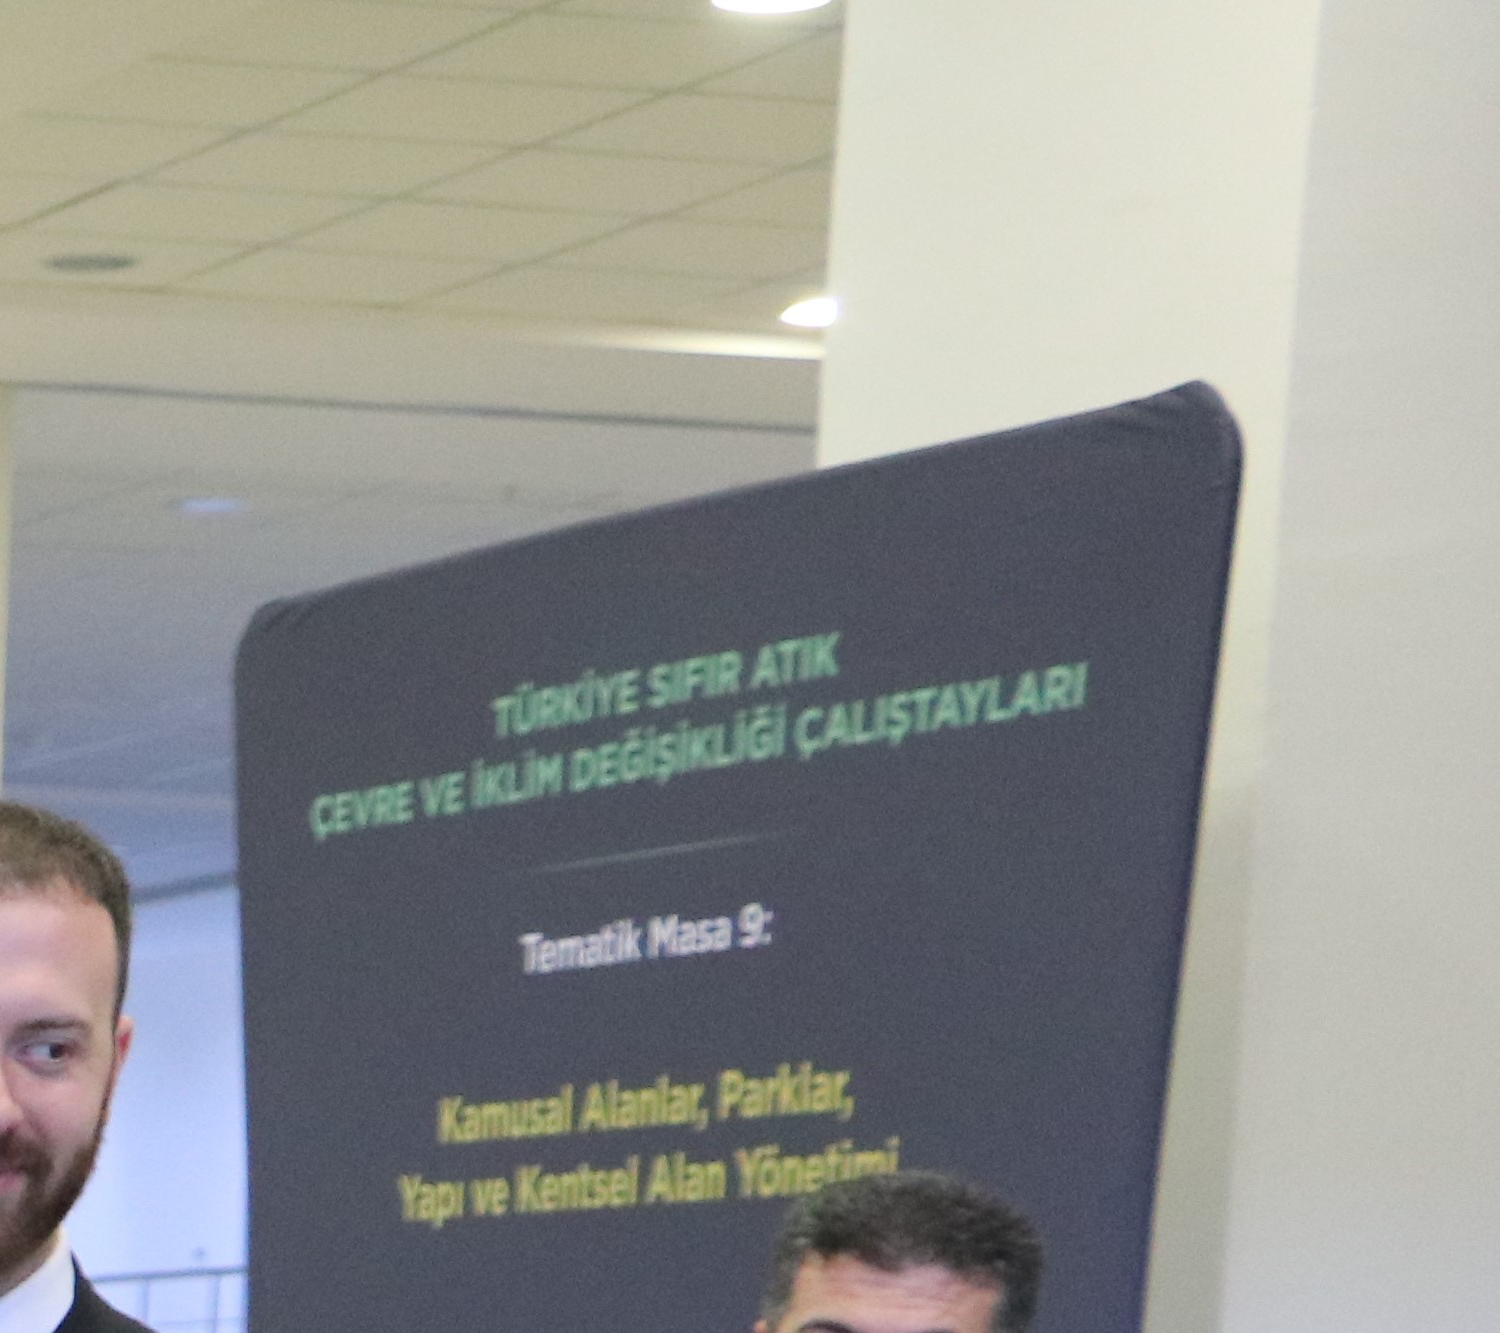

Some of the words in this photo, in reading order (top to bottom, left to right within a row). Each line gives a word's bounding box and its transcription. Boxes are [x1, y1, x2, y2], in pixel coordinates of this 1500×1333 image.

[491, 668, 642, 738] TÜRKİYE
[647, 650, 743, 708] SIFIR
[749, 631, 841, 689] ATIK
[308, 781, 414, 842] ÇEVRE
[417, 771, 466, 818] VE
[470, 750, 563, 808] İKLİM
[568, 703, 788, 794] DEĞİŞİKLİĞİ
[794, 662, 1088, 761] ÇALIŞTAYLARI
[518, 918, 642, 976] Tematik
[647, 914, 733, 959] Masa
[738, 902, 775, 950] 9:
[437, 1082, 574, 1145] Kamusal
[578, 1073, 708, 1132] Alanlar,
[716, 1061, 854, 1121] Parklar,
[398, 1173, 466, 1230] Yapı
[469, 1177, 510, 1216] ve
[514, 1154, 638, 1216] Kentsel
[646, 1151, 726, 1205] Alan
